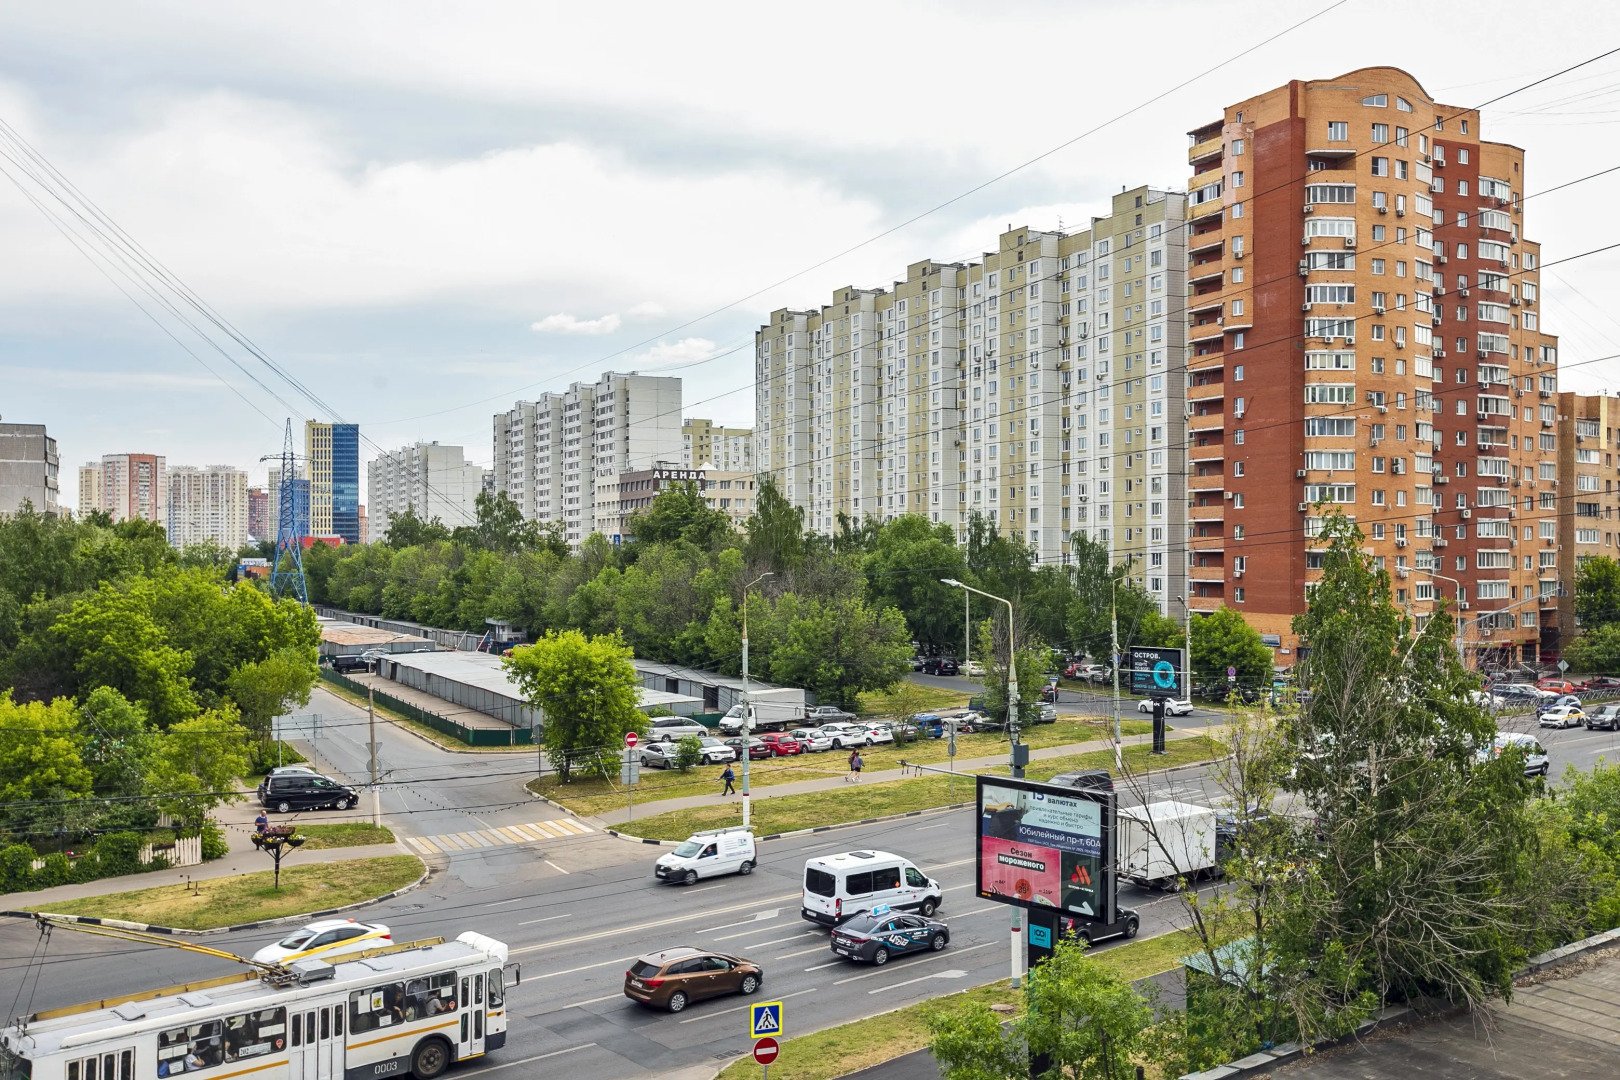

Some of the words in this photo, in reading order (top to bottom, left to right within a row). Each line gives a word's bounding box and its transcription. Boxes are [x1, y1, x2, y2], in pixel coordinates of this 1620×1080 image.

[653, 471, 705, 479] АРЕНДА
[1048, 798, 1077, 808] валютах
[1019, 826, 1065, 842] Юбилейный
[1010, 847, 1032, 858] Сезон
[999, 855, 1045, 870] мороженого
[374, 1061, 398, 1075] 0003
